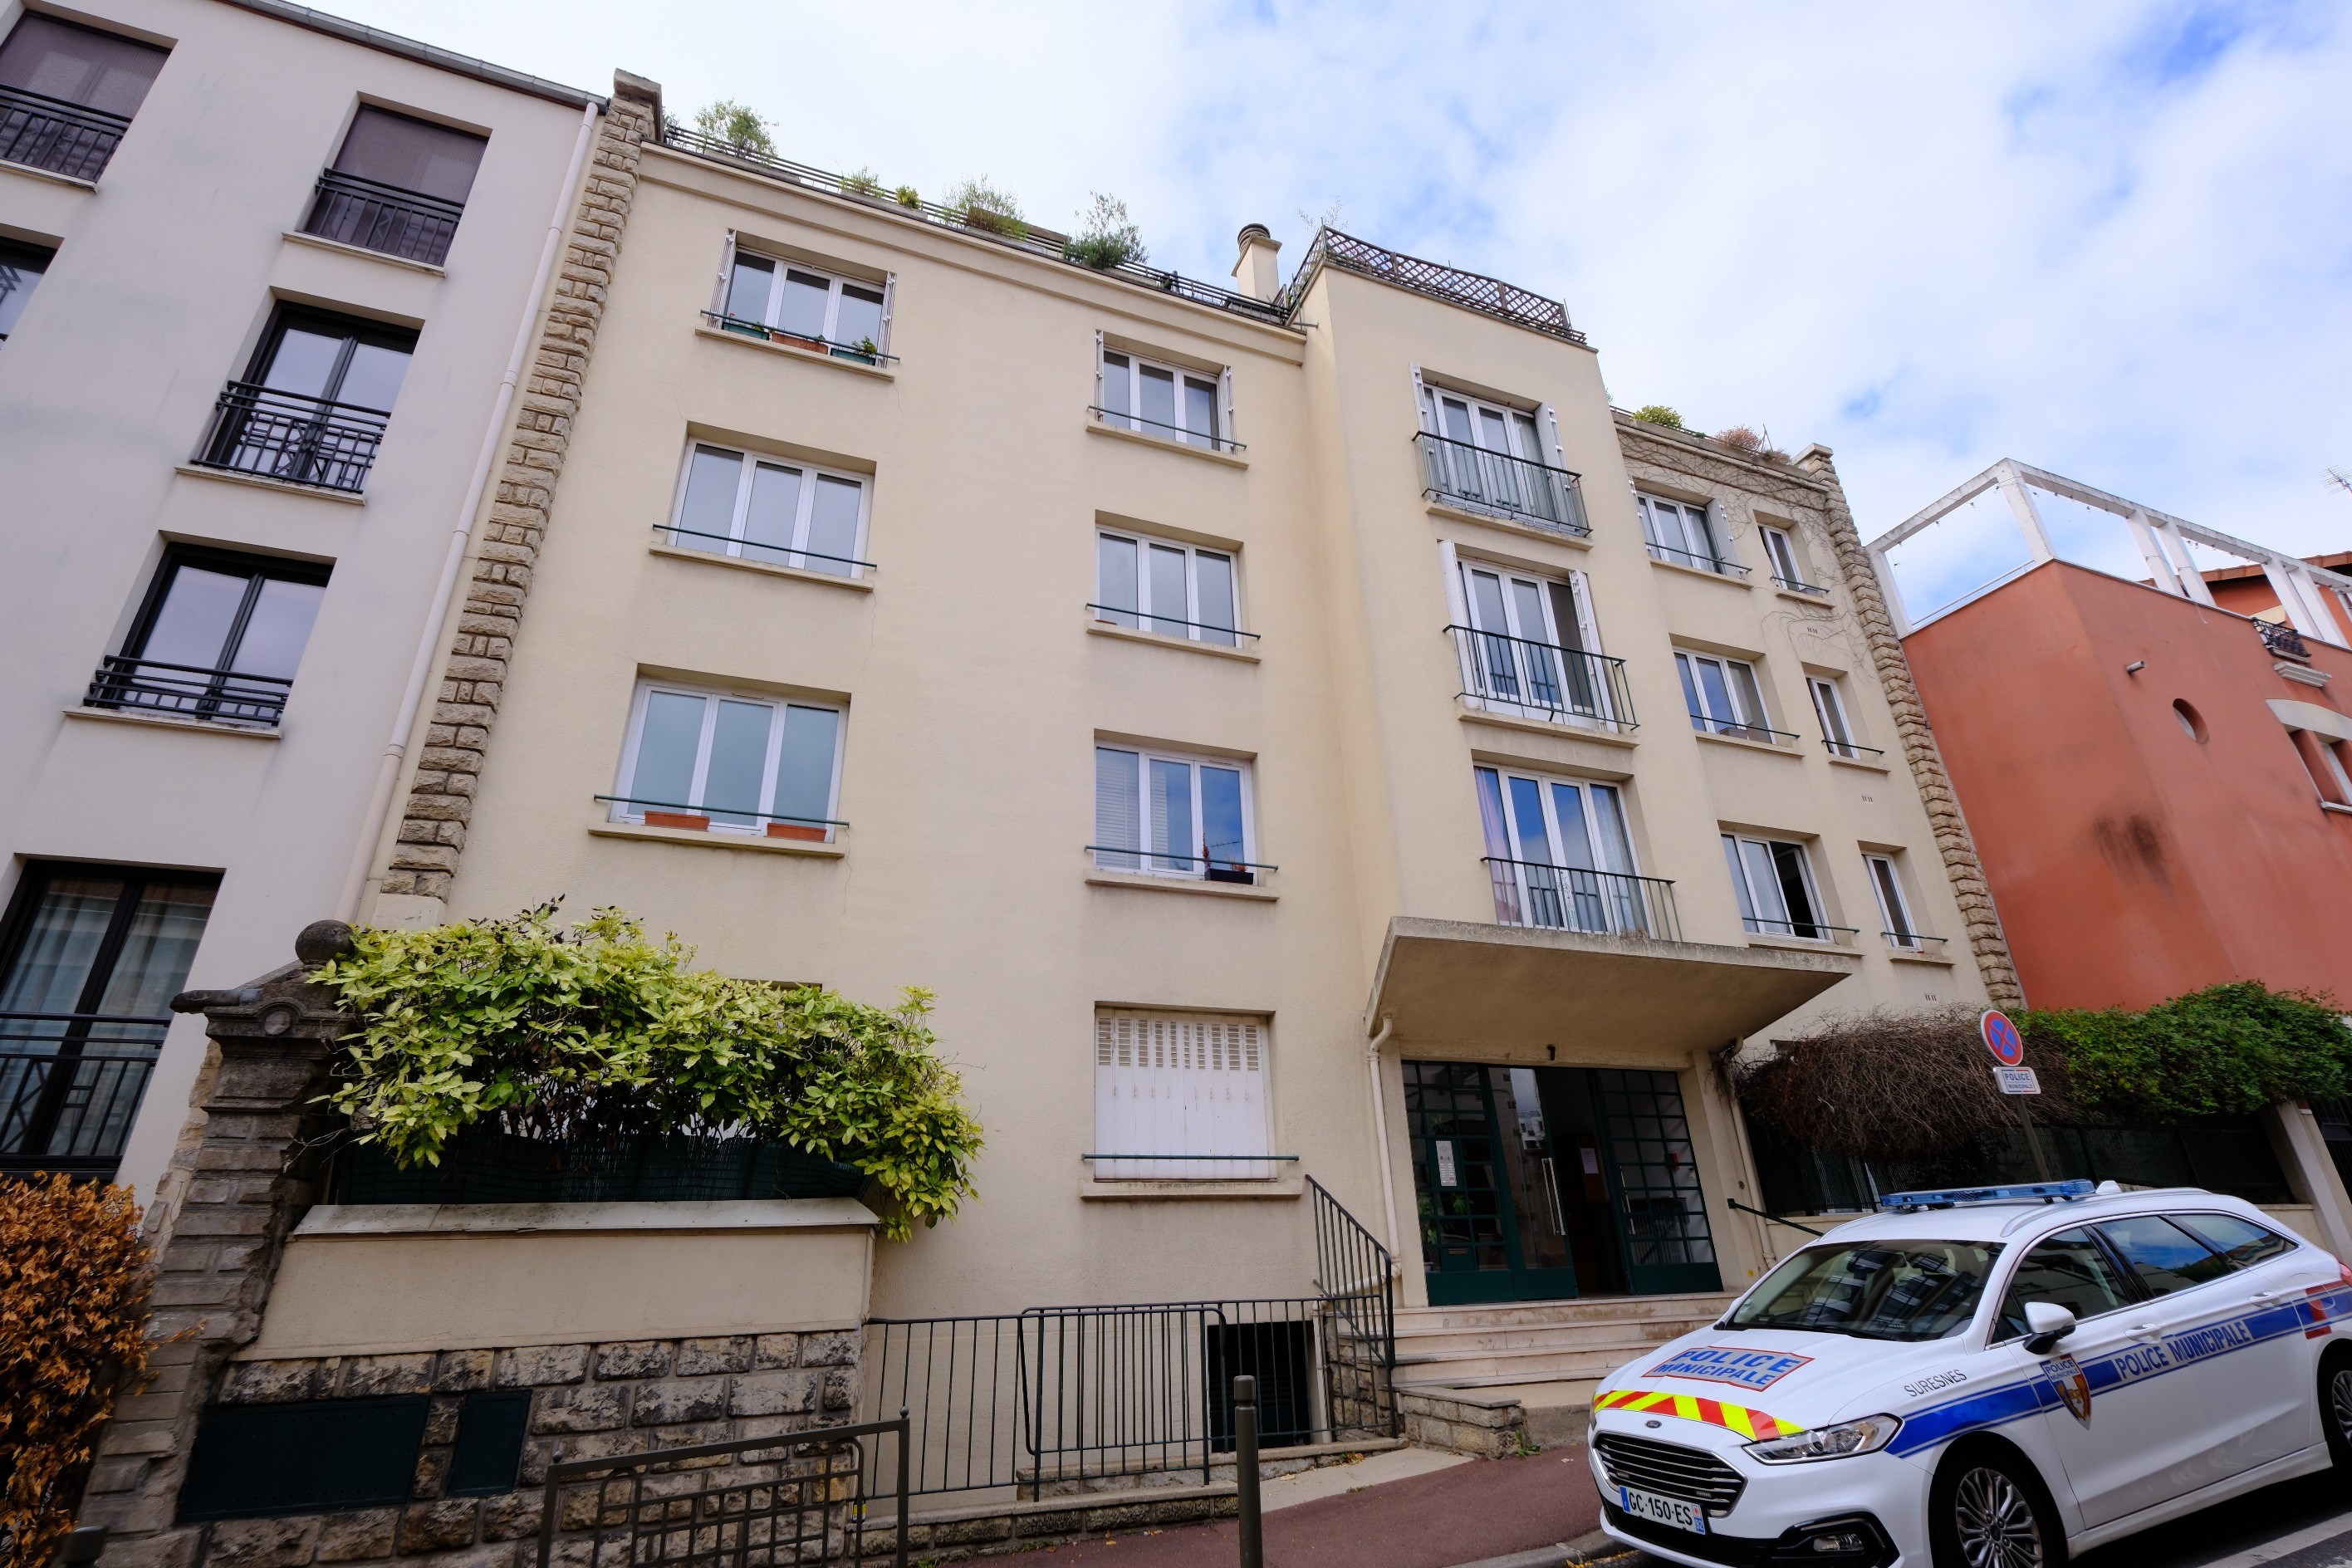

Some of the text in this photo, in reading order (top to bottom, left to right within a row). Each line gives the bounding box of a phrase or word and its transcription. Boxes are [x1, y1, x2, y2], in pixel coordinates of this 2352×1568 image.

[1670, 1350, 1801, 1373] POLICE
[2114, 1321, 2251, 1379] POLICE MUNICIPALE
[1653, 1362, 1776, 1385] MUNICIPALE
[2045, 1359, 2075, 1374] POLICE
[1904, 1369, 1967, 1398] SURESNES
